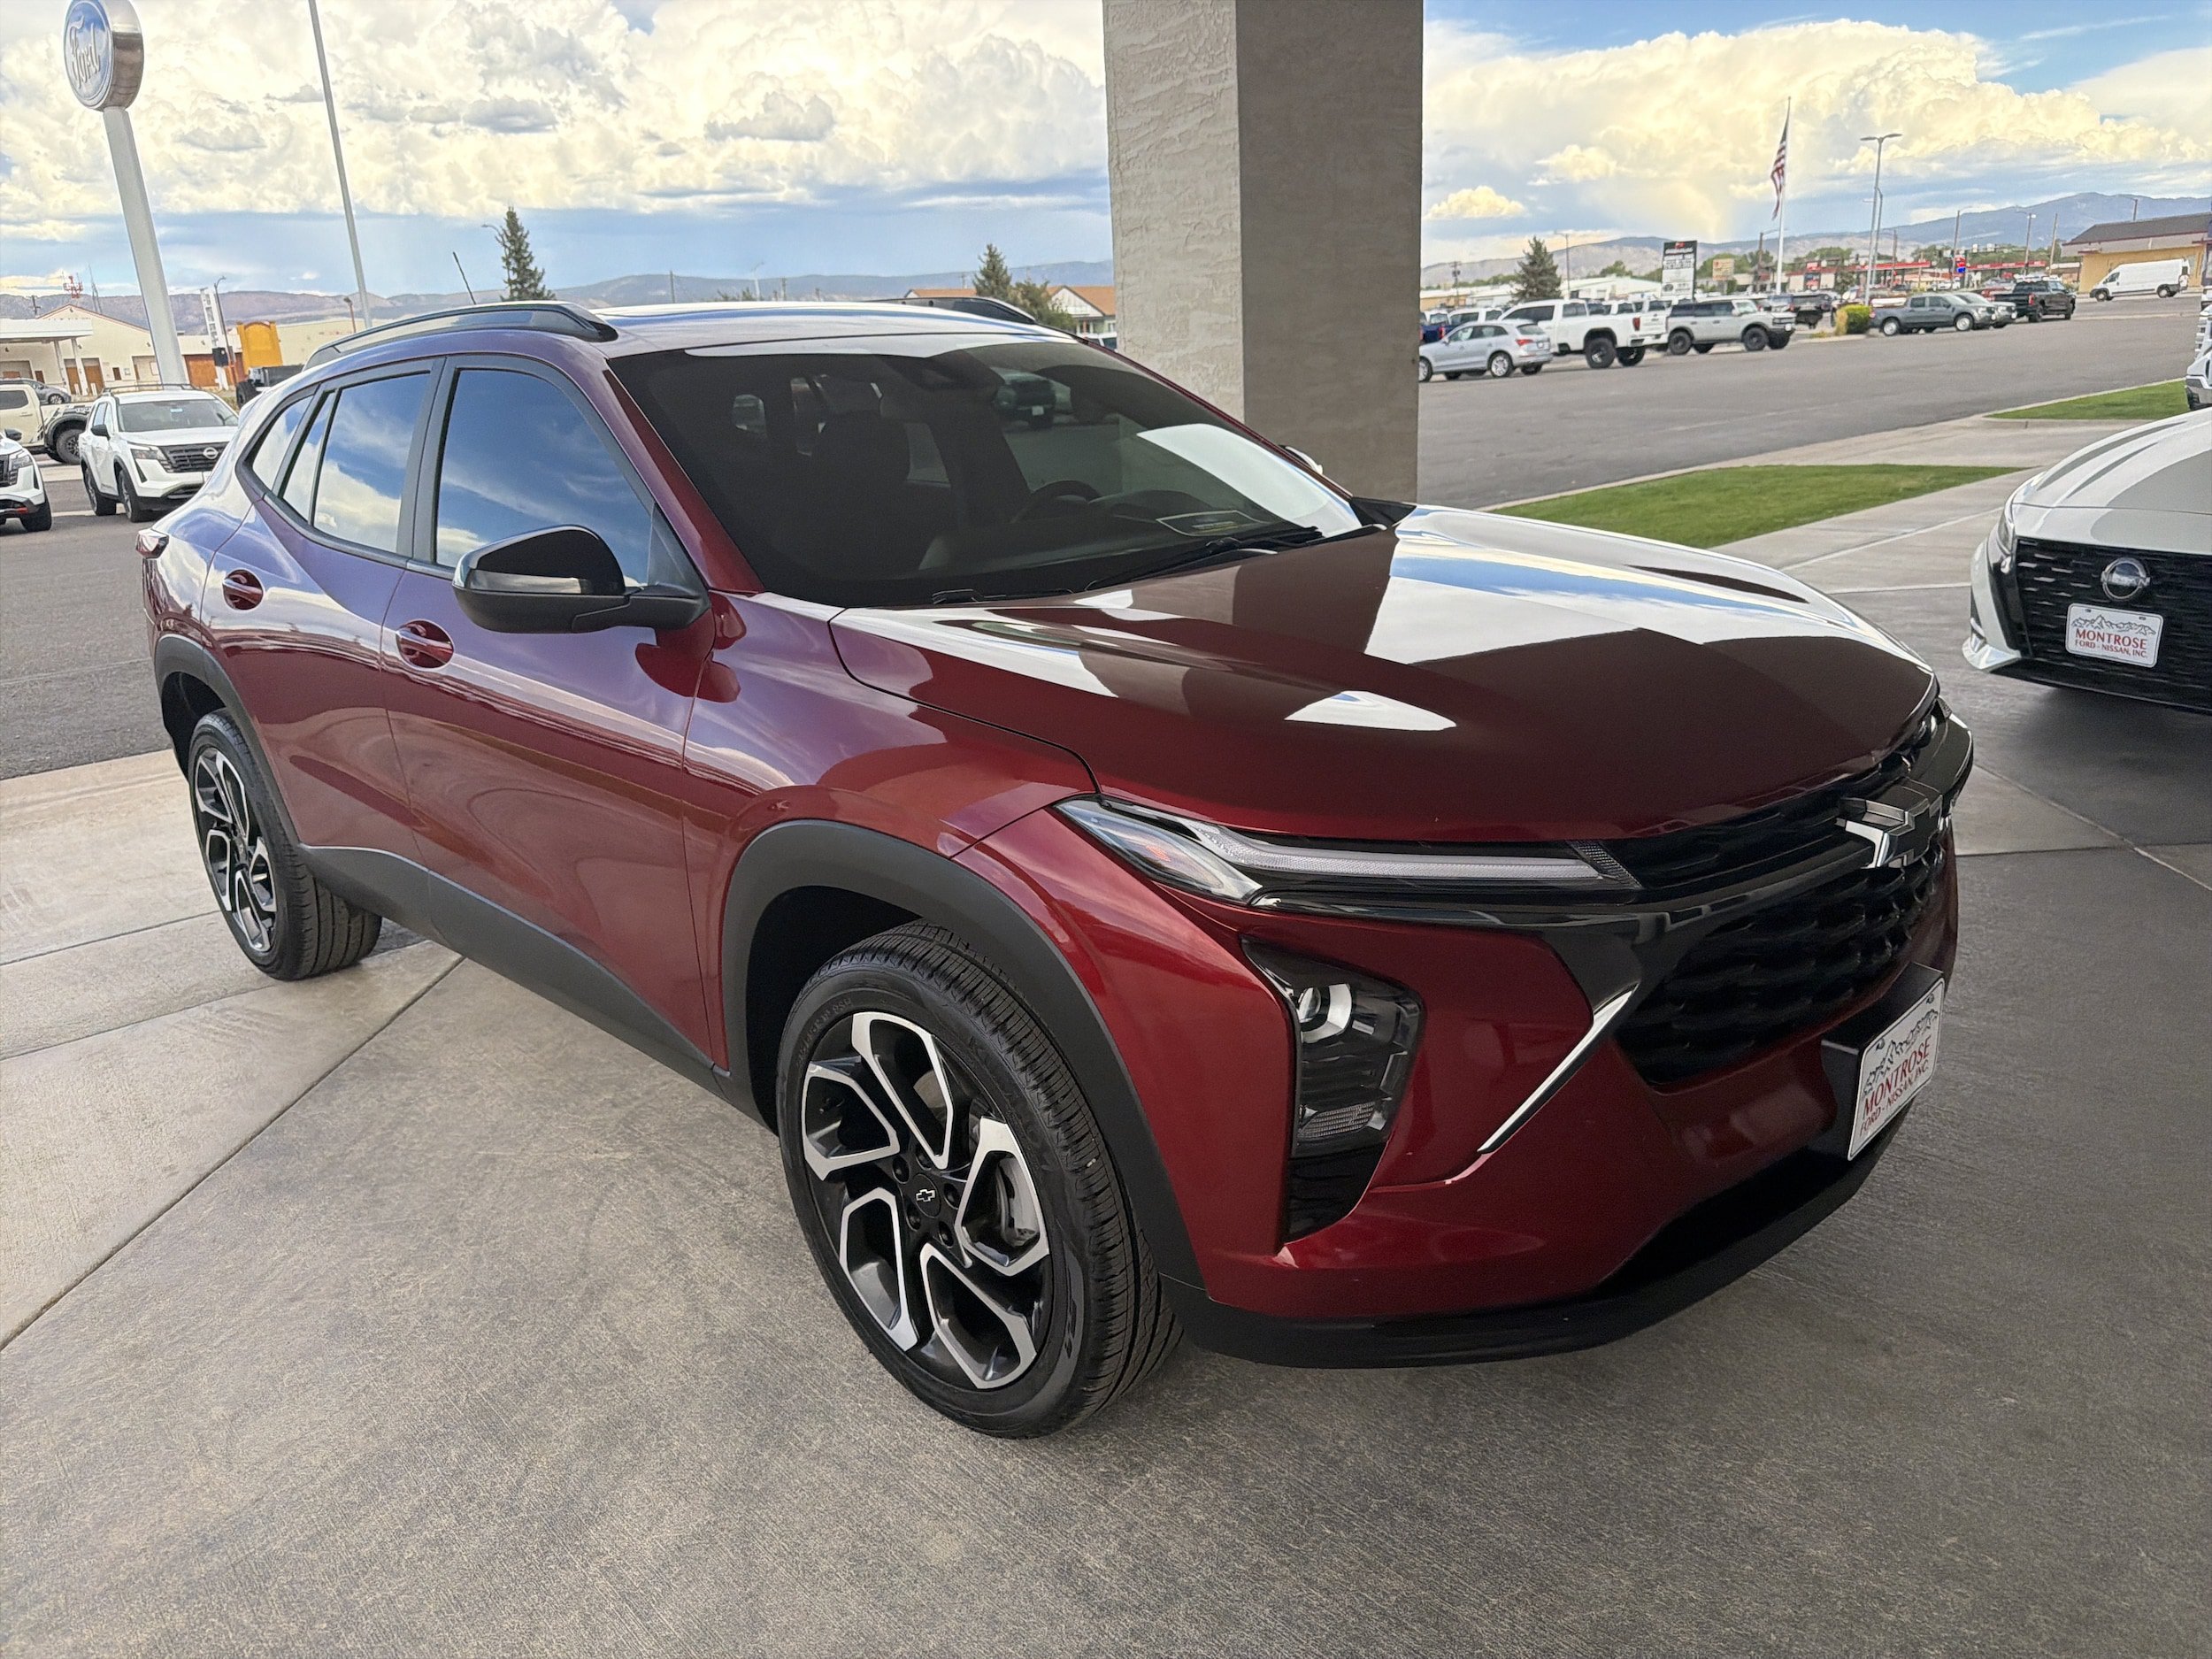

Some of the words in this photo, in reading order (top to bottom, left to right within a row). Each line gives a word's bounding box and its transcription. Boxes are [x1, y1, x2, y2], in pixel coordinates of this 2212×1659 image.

[69, 16, 101, 88] Ford
[2074, 639, 2096, 649] FORD
[2101, 643, 2131, 657] NISSAN,
[2075, 627, 2148, 650] MONTROSE
[1863, 1034, 1932, 1120] MONTROSE
[1860, 1106, 1881, 1137] FORD
